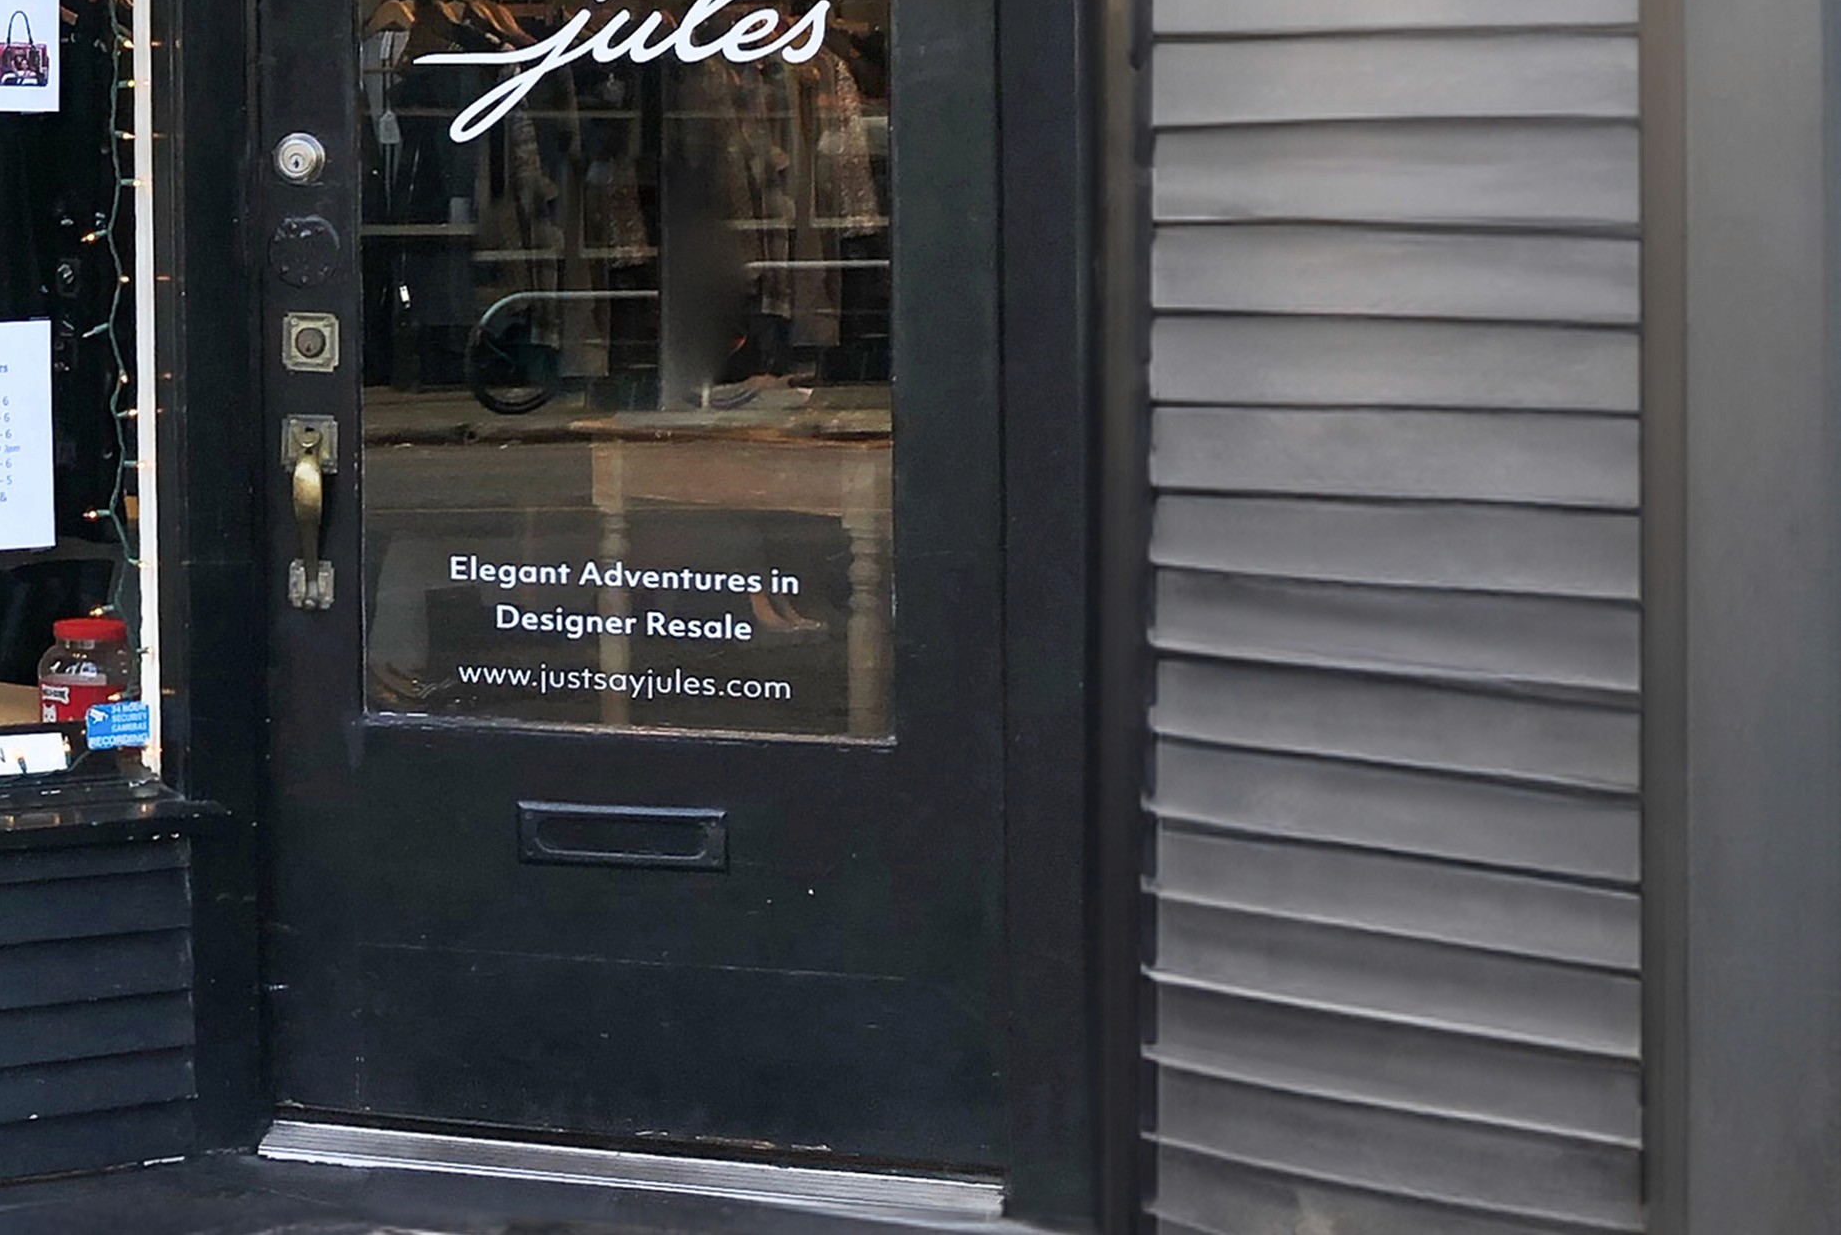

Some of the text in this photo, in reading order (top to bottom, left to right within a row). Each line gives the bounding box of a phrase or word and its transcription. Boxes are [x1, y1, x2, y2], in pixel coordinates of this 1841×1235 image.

[2, 395, 10, 406] 6
[3, 412, 11, 423] 6
[5, 429, 12, 439] 6
[5, 458, 12, 468] 6
[6, 475, 13, 485] 5
[448, 555, 800, 595] Elegant Adventures in
[495, 603, 753, 642] Designer Resale
[458, 663, 793, 701] www.justsayjules.com
